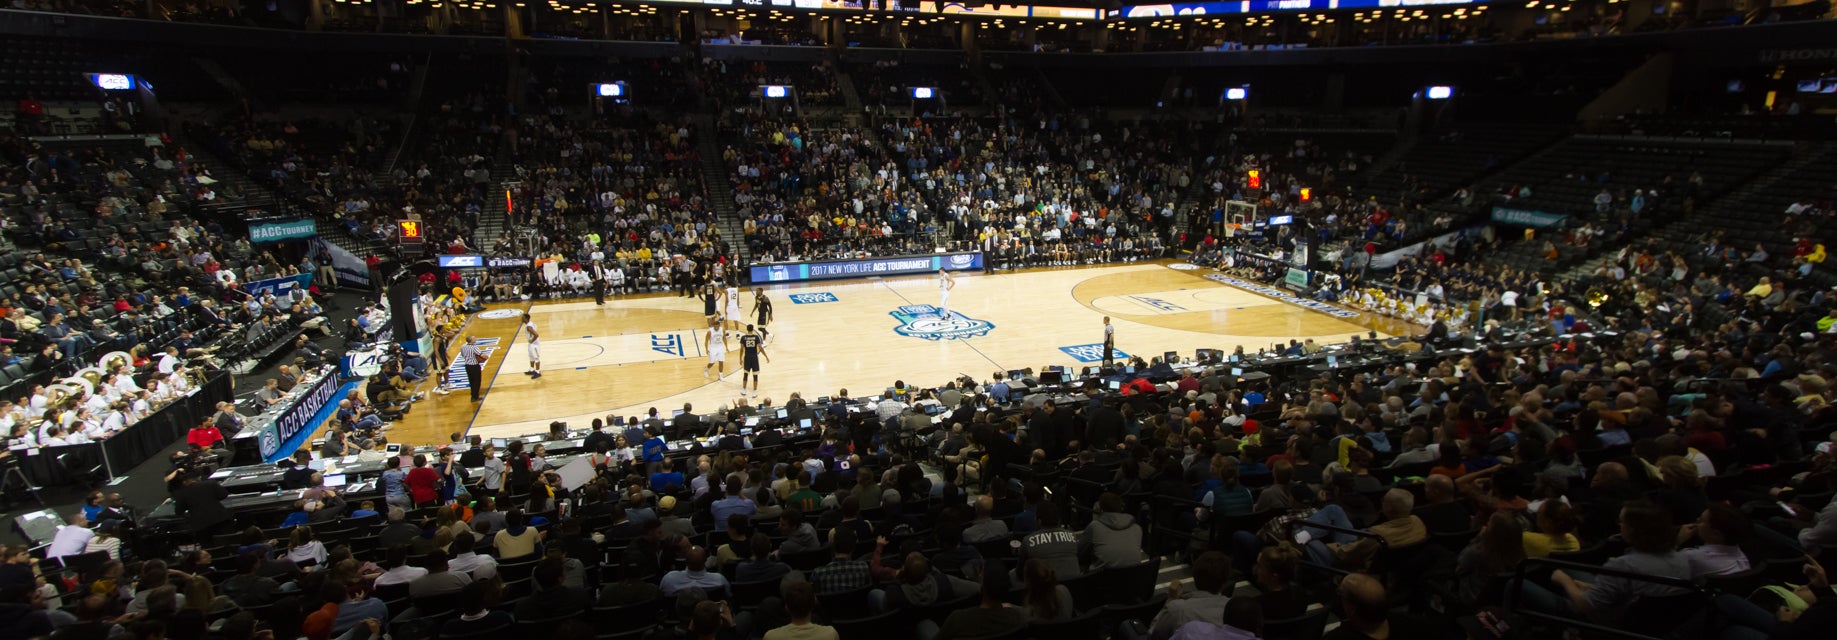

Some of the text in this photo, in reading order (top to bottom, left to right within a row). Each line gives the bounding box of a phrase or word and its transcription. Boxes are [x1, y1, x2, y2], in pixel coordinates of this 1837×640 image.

[405, 228, 417, 236] 30
[811, 258, 930, 275] 2017 NEW YORK LIFE ACC TOURNAMENT
[651, 334, 678, 355] ACC
[279, 408, 300, 444] ACC
[298, 372, 339, 427] BASKETBALL
[802, 498, 814, 512] 11
[1029, 531, 1077, 547] STAY TRUE
